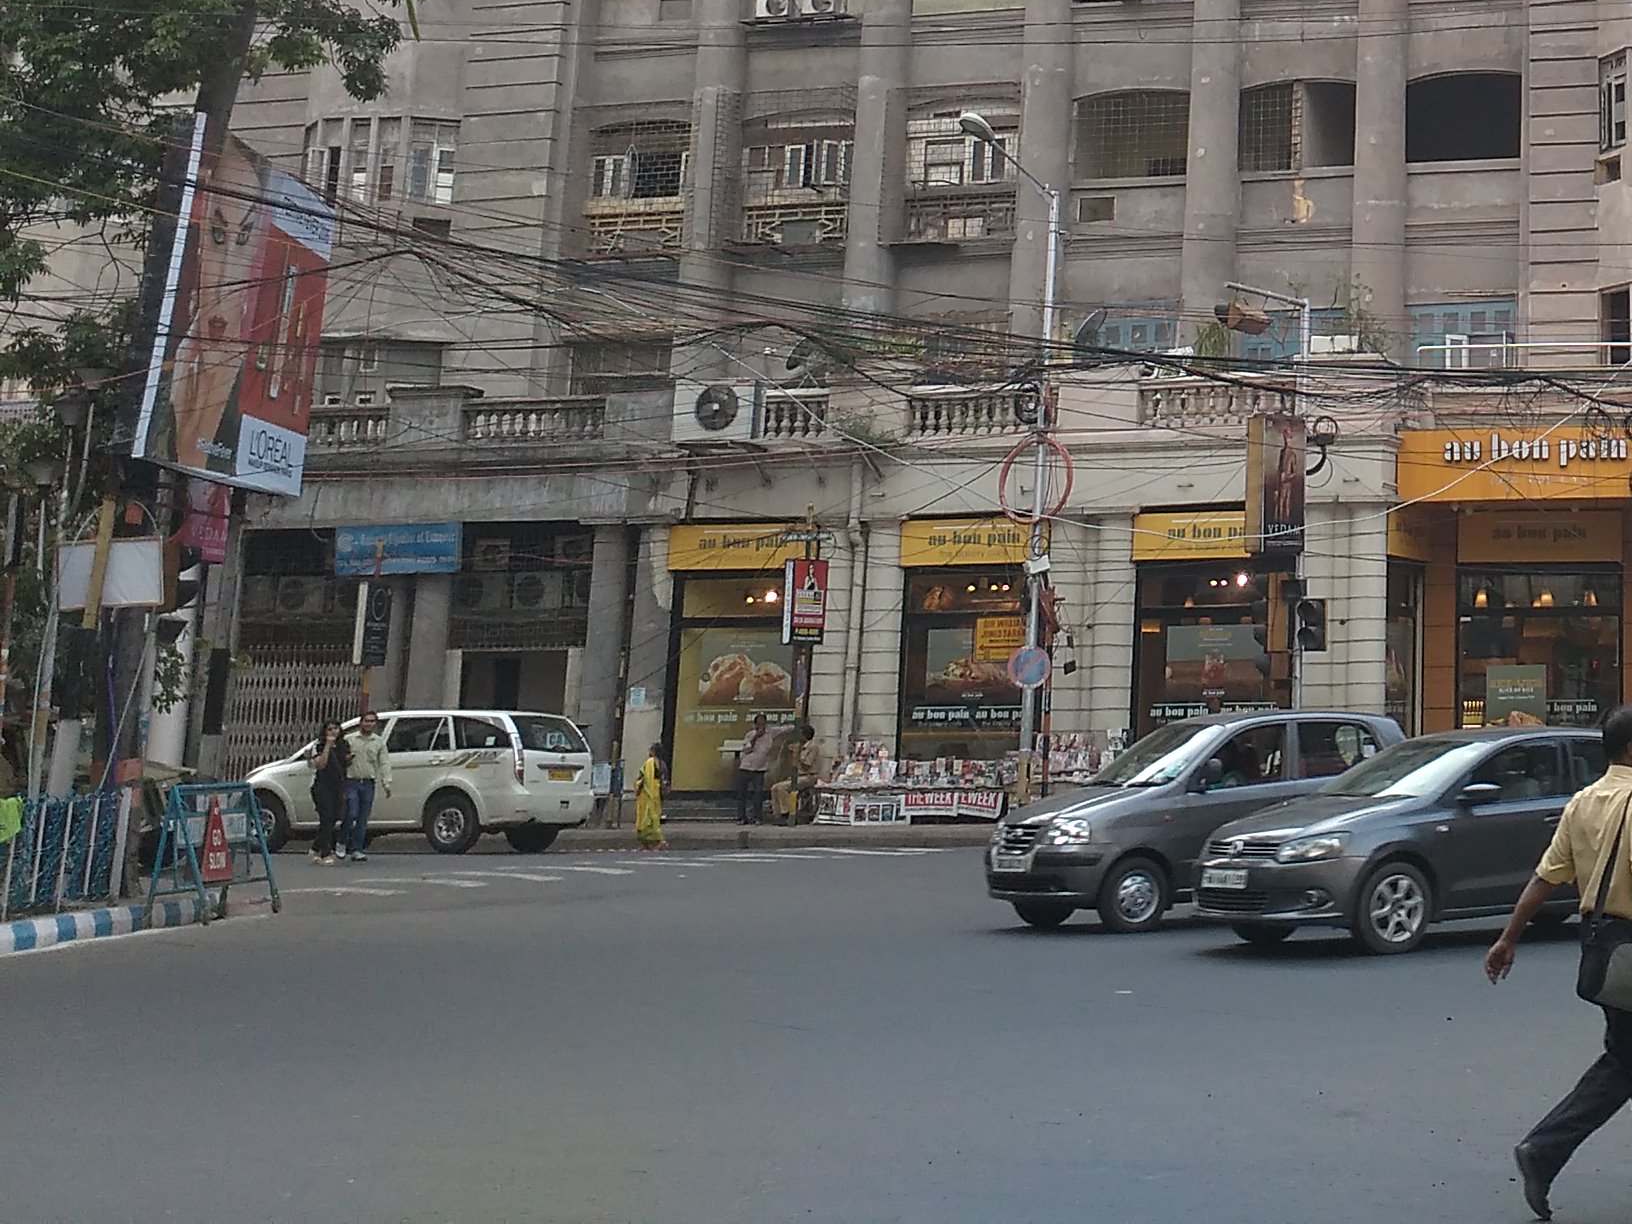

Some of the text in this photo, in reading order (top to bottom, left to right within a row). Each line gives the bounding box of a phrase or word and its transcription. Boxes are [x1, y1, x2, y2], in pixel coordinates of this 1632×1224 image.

[1443, 432, 1628, 467] au bon pain
[928, 530, 1020, 547] au bon pain
[1192, 524, 1221, 538] bon
[926, 709, 945, 719] bon
[990, 709, 1009, 719] bon
[1165, 705, 1184, 717] bon
[924, 791, 953, 805] WEEK
[966, 791, 997, 807] WEEK
[212, 829, 222, 846] GO
[208, 852, 226, 869] SLOW
